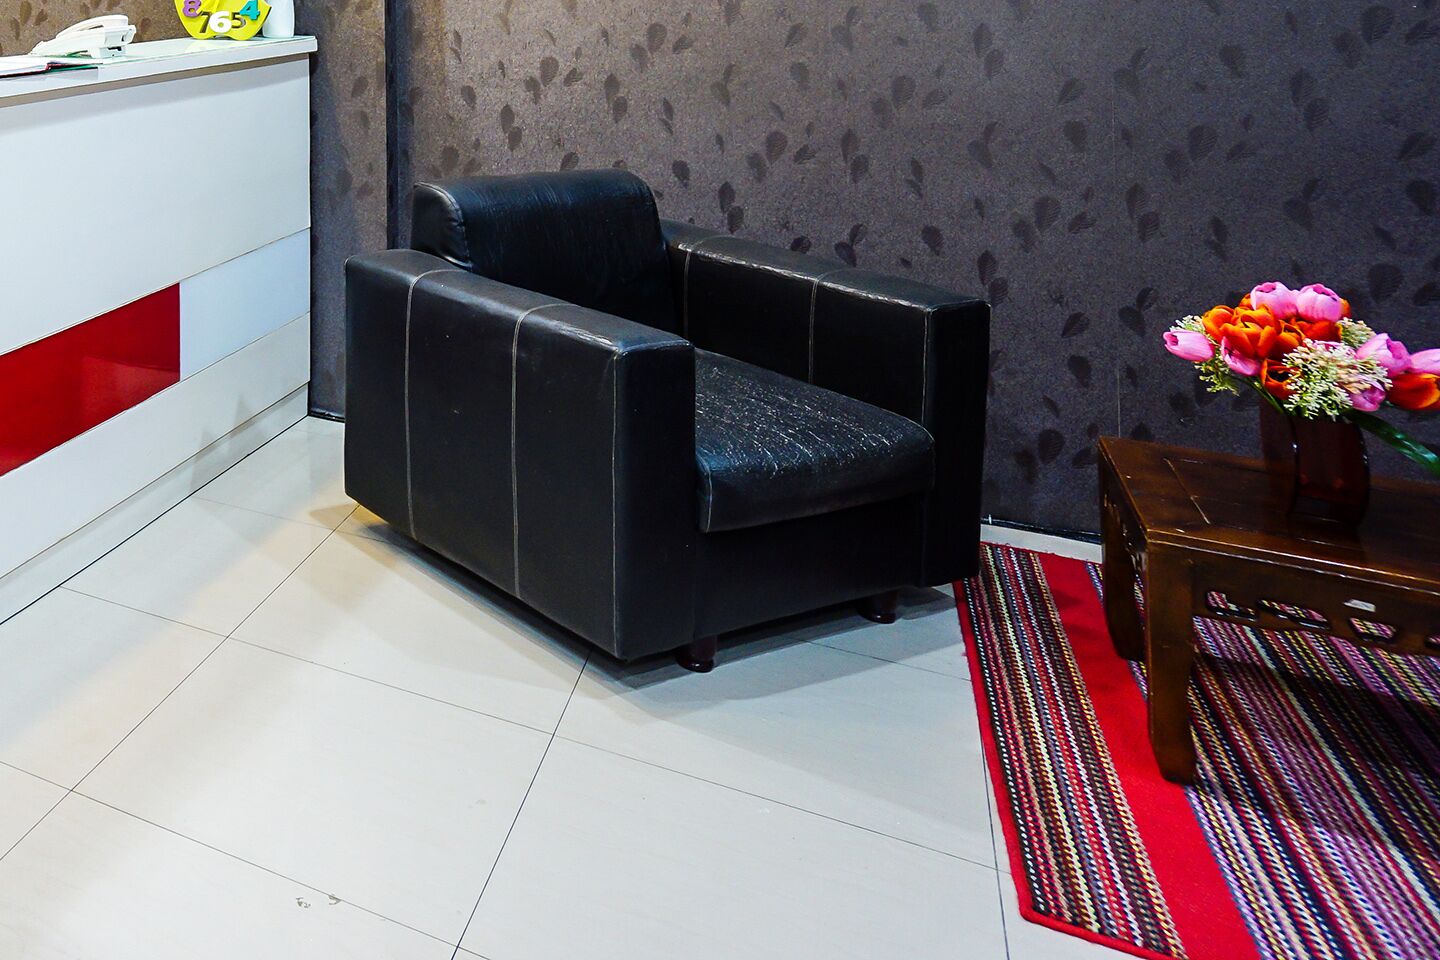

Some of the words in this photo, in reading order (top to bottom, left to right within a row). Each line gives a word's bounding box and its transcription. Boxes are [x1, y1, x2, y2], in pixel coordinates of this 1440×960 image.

[199, 10, 213, 33] 7
[232, 11, 247, 29] 5
[239, 0, 260, 21] 4
[209, 10, 233, 34] 6
